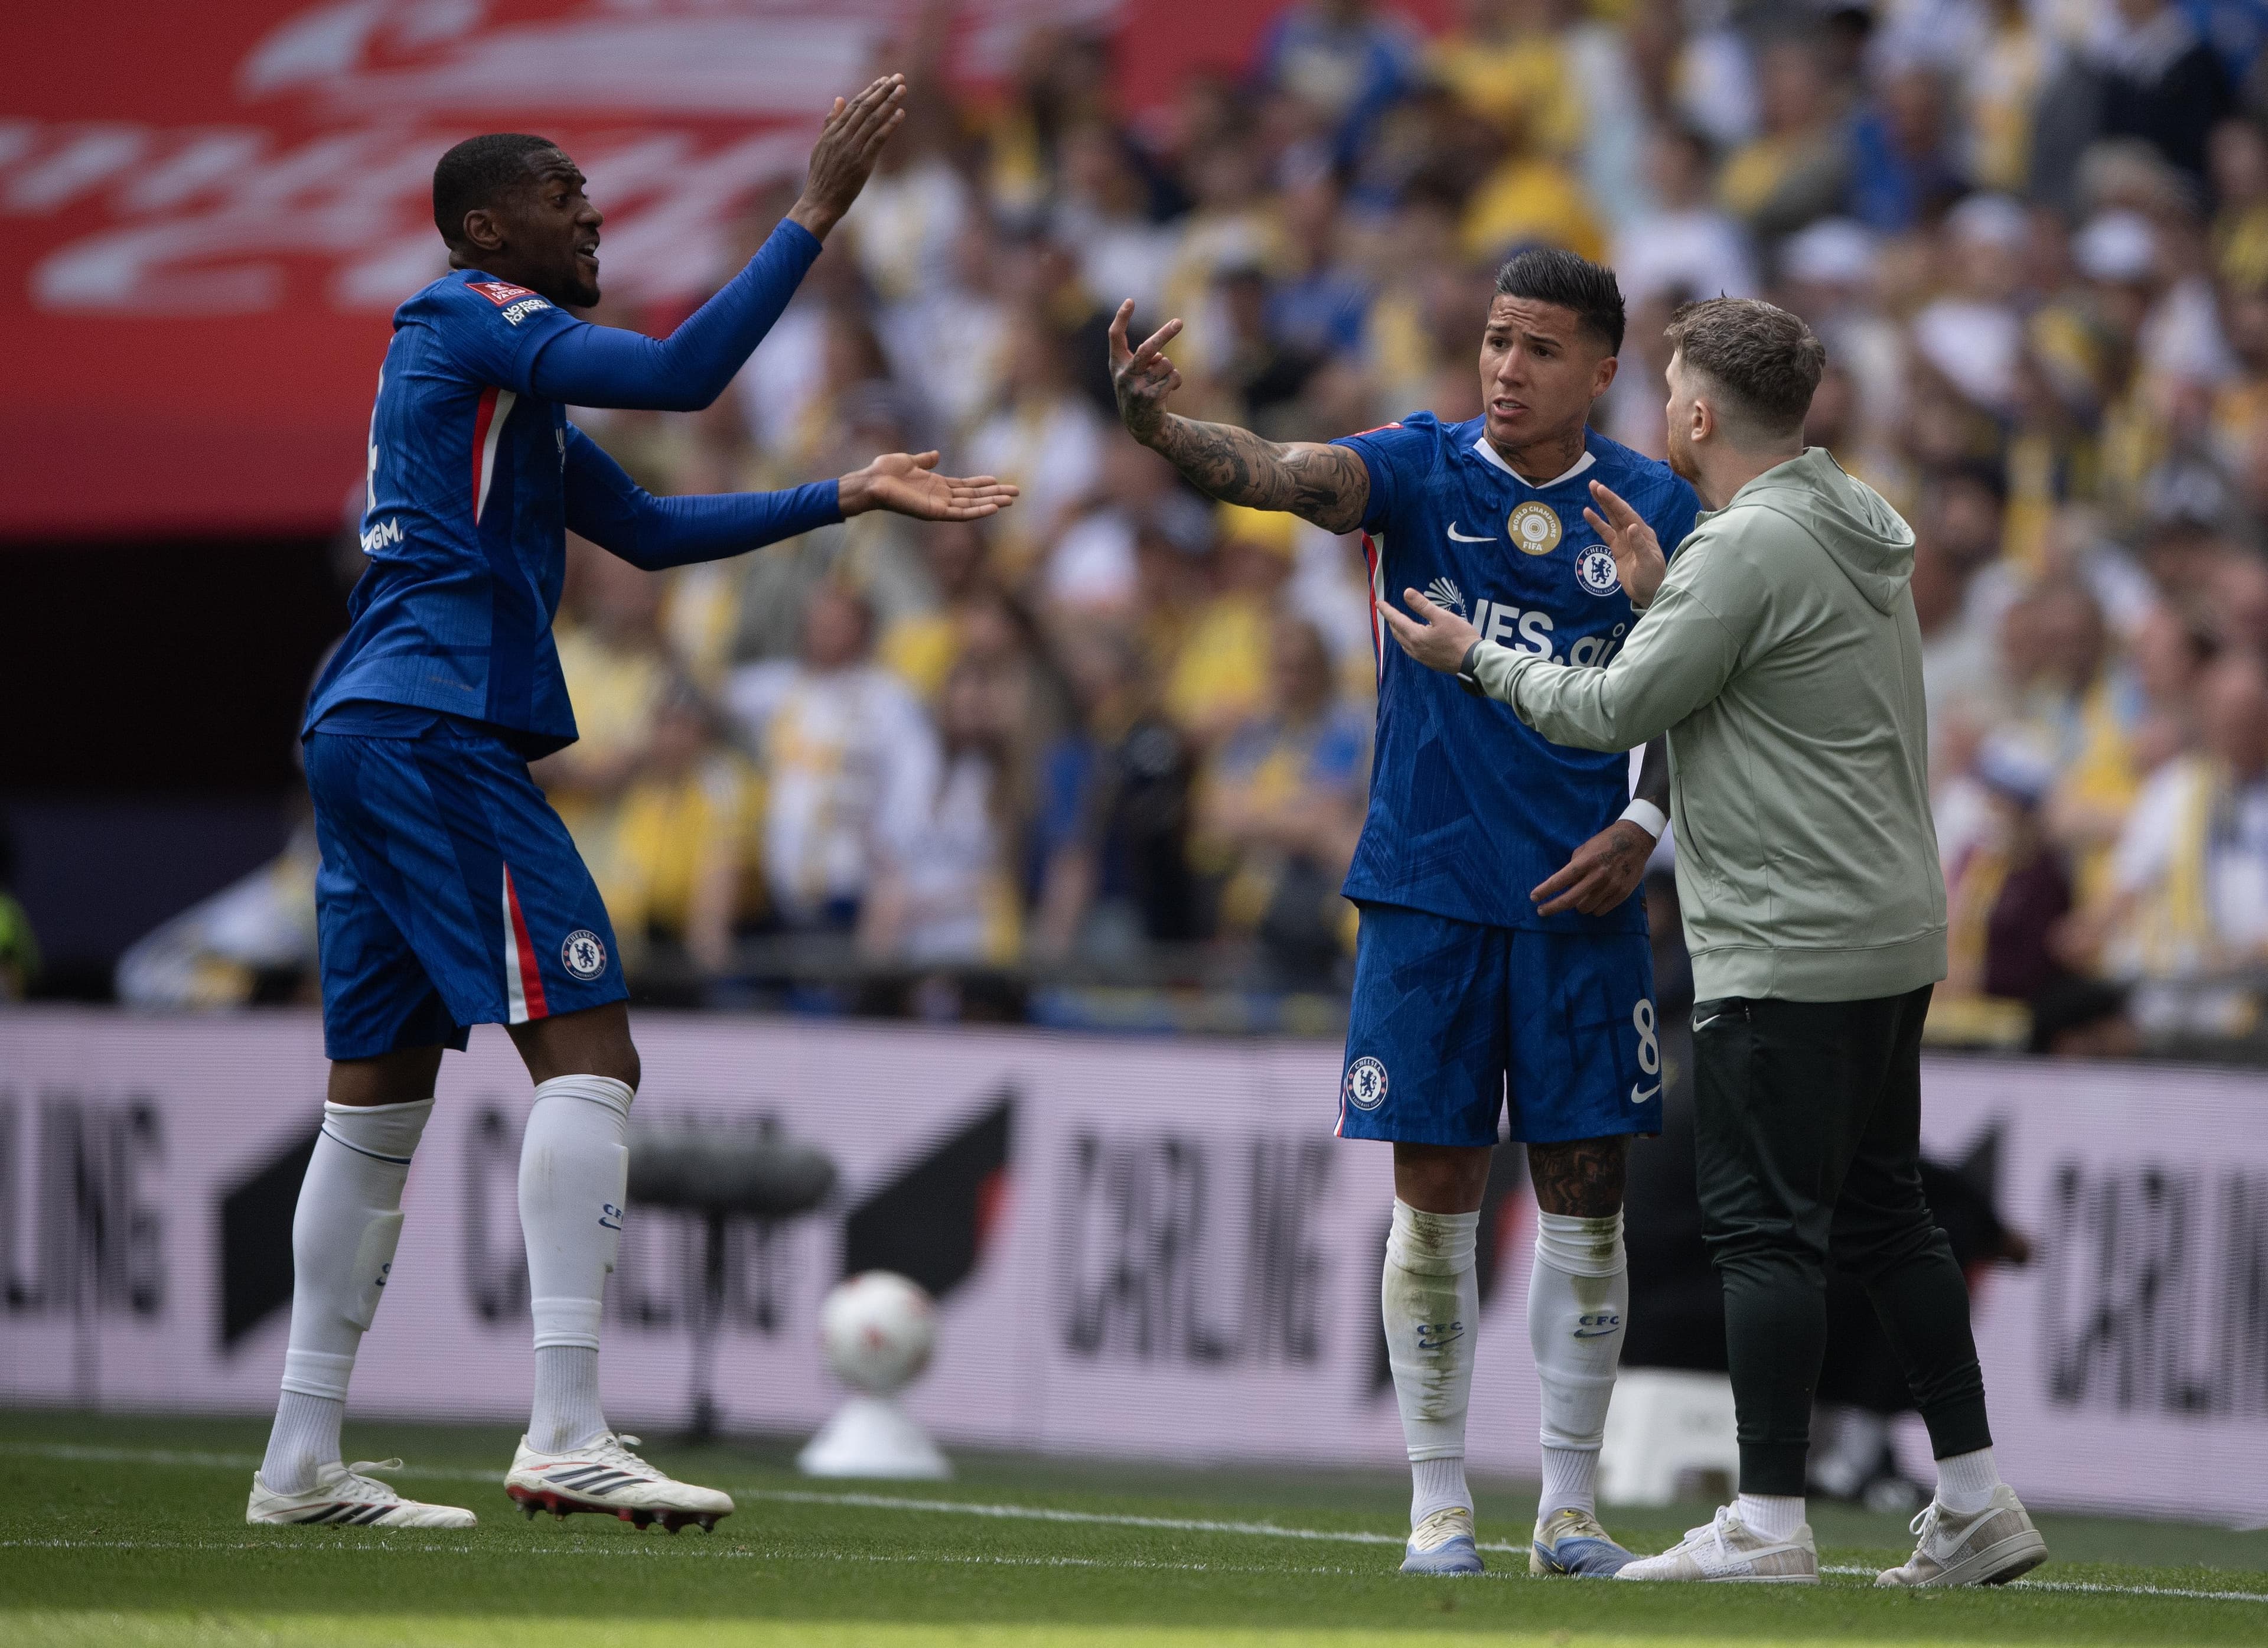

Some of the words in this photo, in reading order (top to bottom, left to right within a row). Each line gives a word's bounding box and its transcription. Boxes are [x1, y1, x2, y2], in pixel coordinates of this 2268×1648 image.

[1513, 508, 1528, 532] WORLD
[1529, 506, 1556, 538] CHAMPIONS
[1523, 541, 1543, 551] FIFA
[1585, 546, 1615, 561] CHELSE
[567, 932, 595, 945] CHELSEA
[1633, 999, 1659, 1074] 8
[1354, 1059, 1381, 1071] CHELSEA
[603, 1203, 624, 1225] CF
[1579, 1315, 1619, 1326] CFC
[1416, 1321, 1464, 1336] CFC
